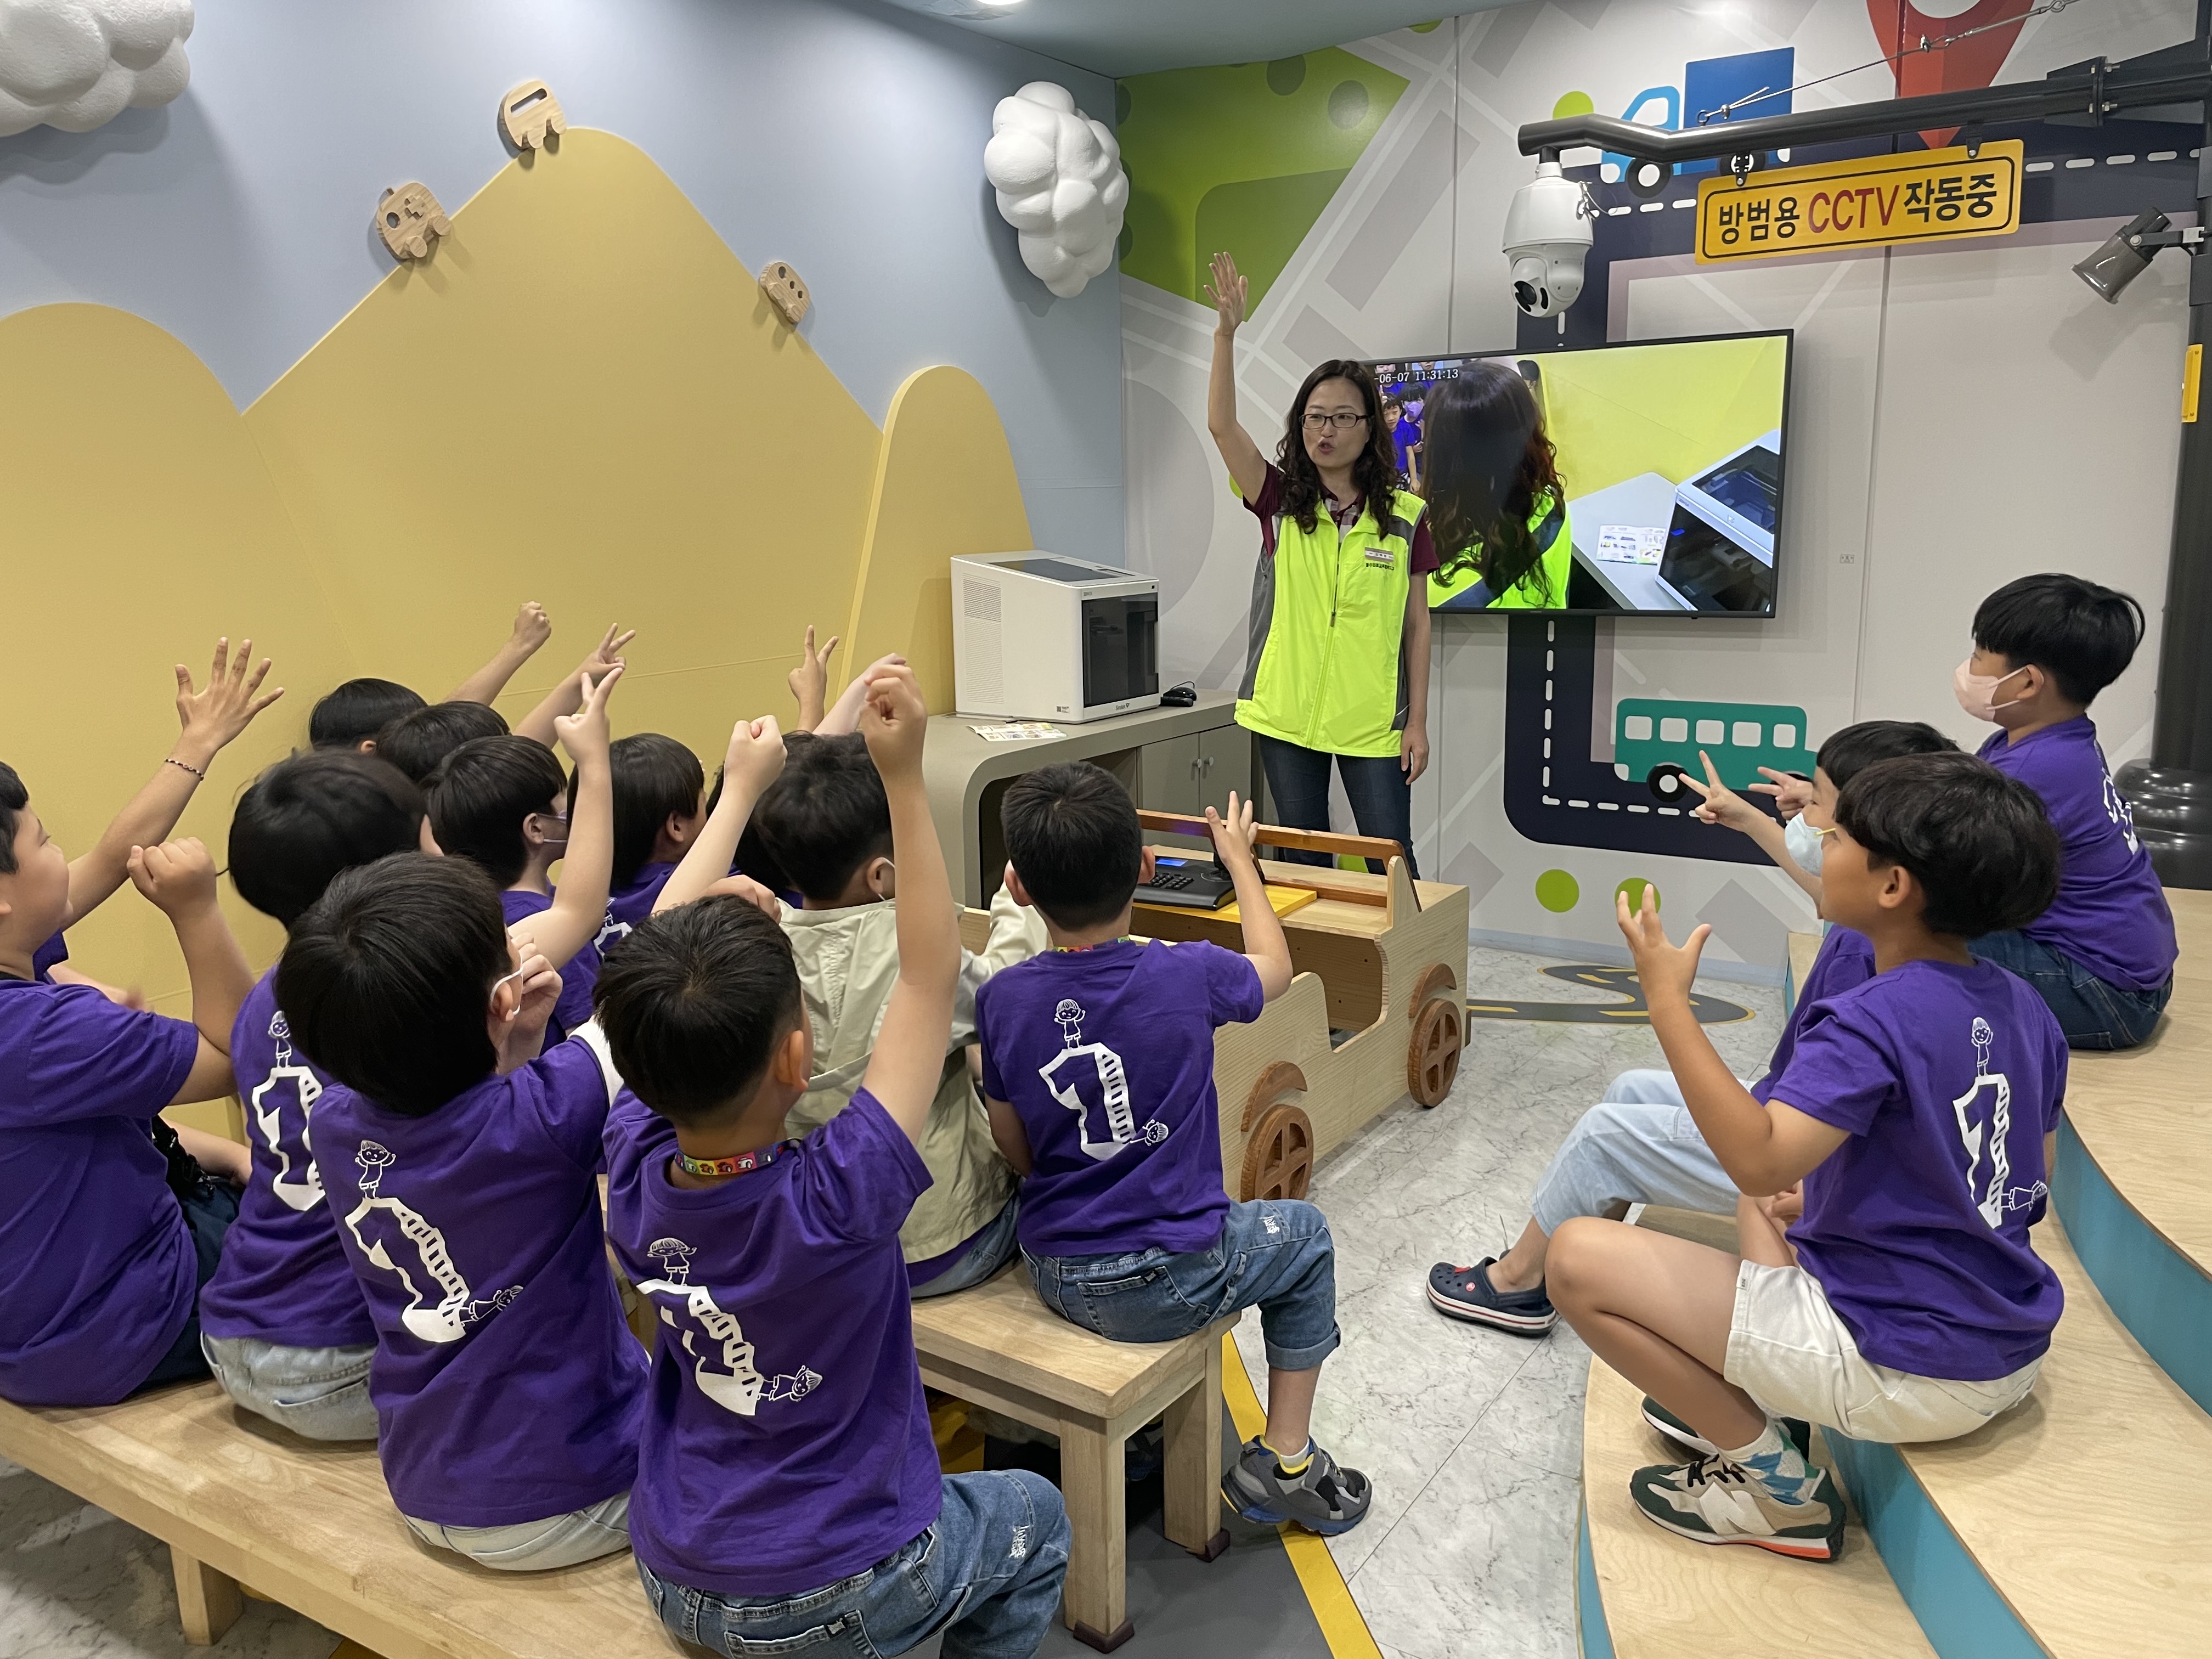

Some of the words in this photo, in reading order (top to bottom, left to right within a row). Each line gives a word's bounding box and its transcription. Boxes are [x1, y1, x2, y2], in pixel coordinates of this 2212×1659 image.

[1719, 196, 1799, 245] 방범용
[1808, 185, 1900, 233] CCTV
[1904, 173, 1997, 223] 작동중
[1415, 369, 1459, 381] 11:31:13
